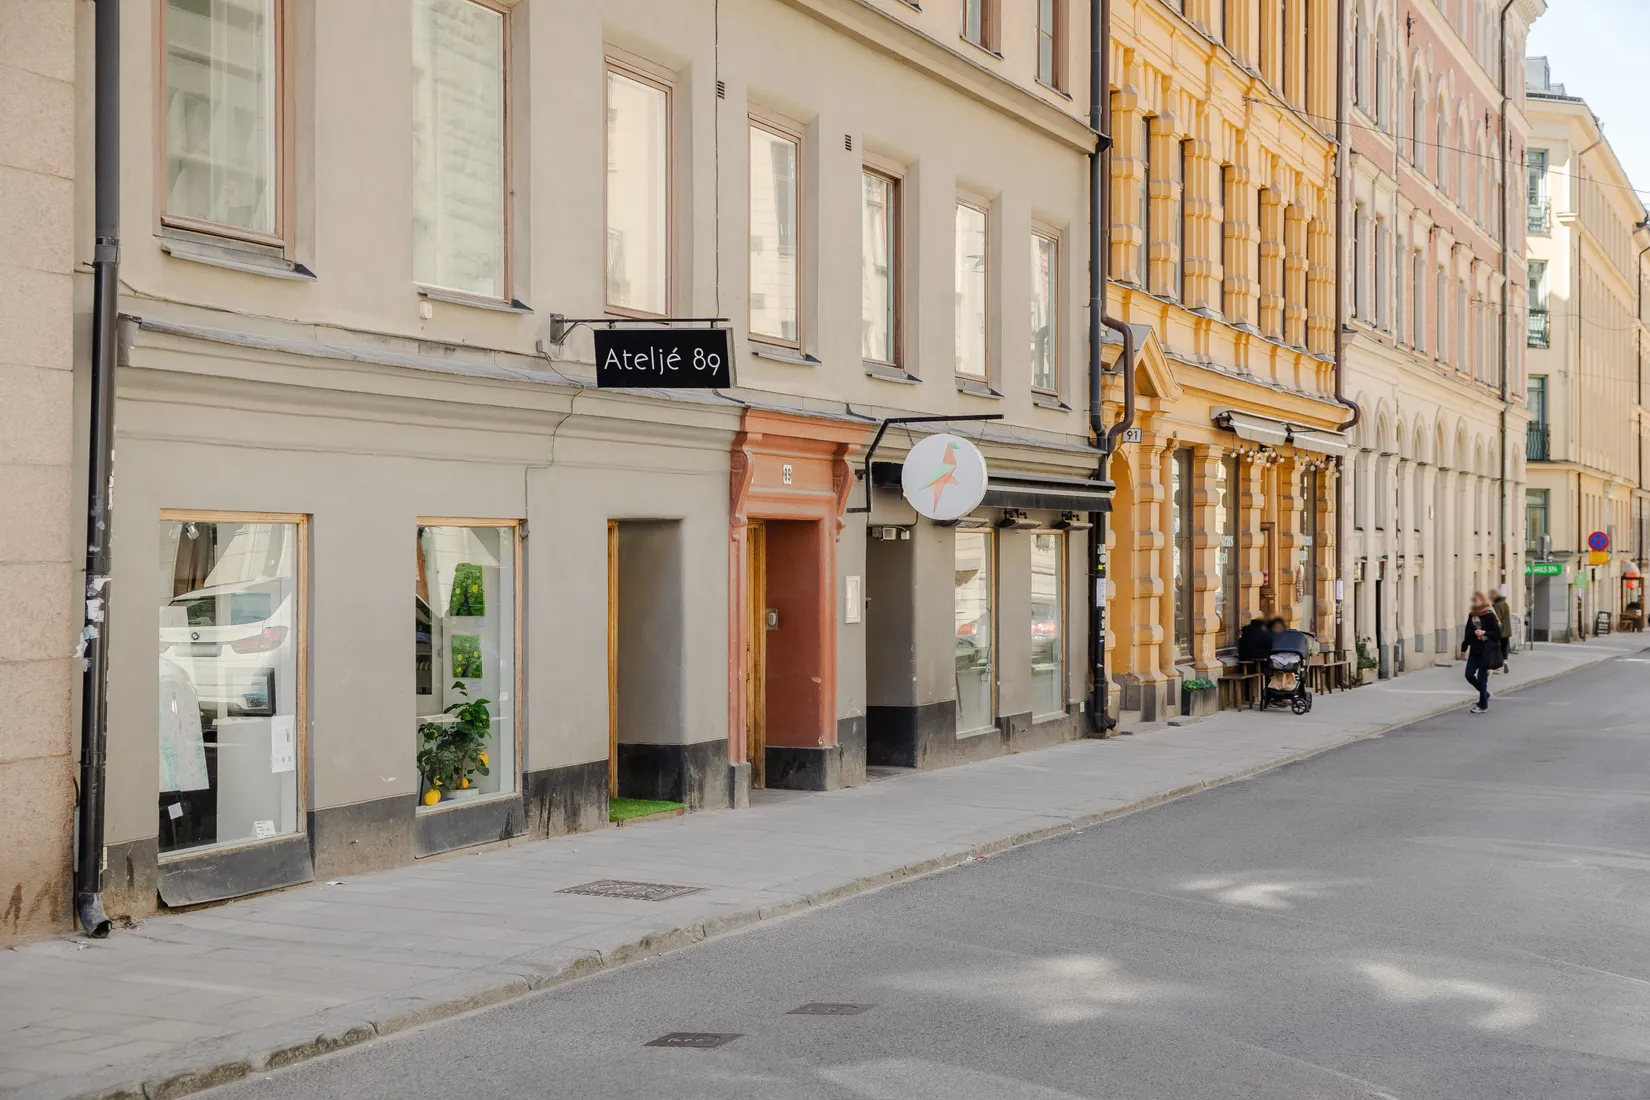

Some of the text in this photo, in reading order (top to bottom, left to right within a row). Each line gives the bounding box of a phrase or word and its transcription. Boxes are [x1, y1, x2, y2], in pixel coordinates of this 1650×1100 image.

[604, 346, 721, 376] Ateljé 89
[1126, 430, 1138, 440] 91
